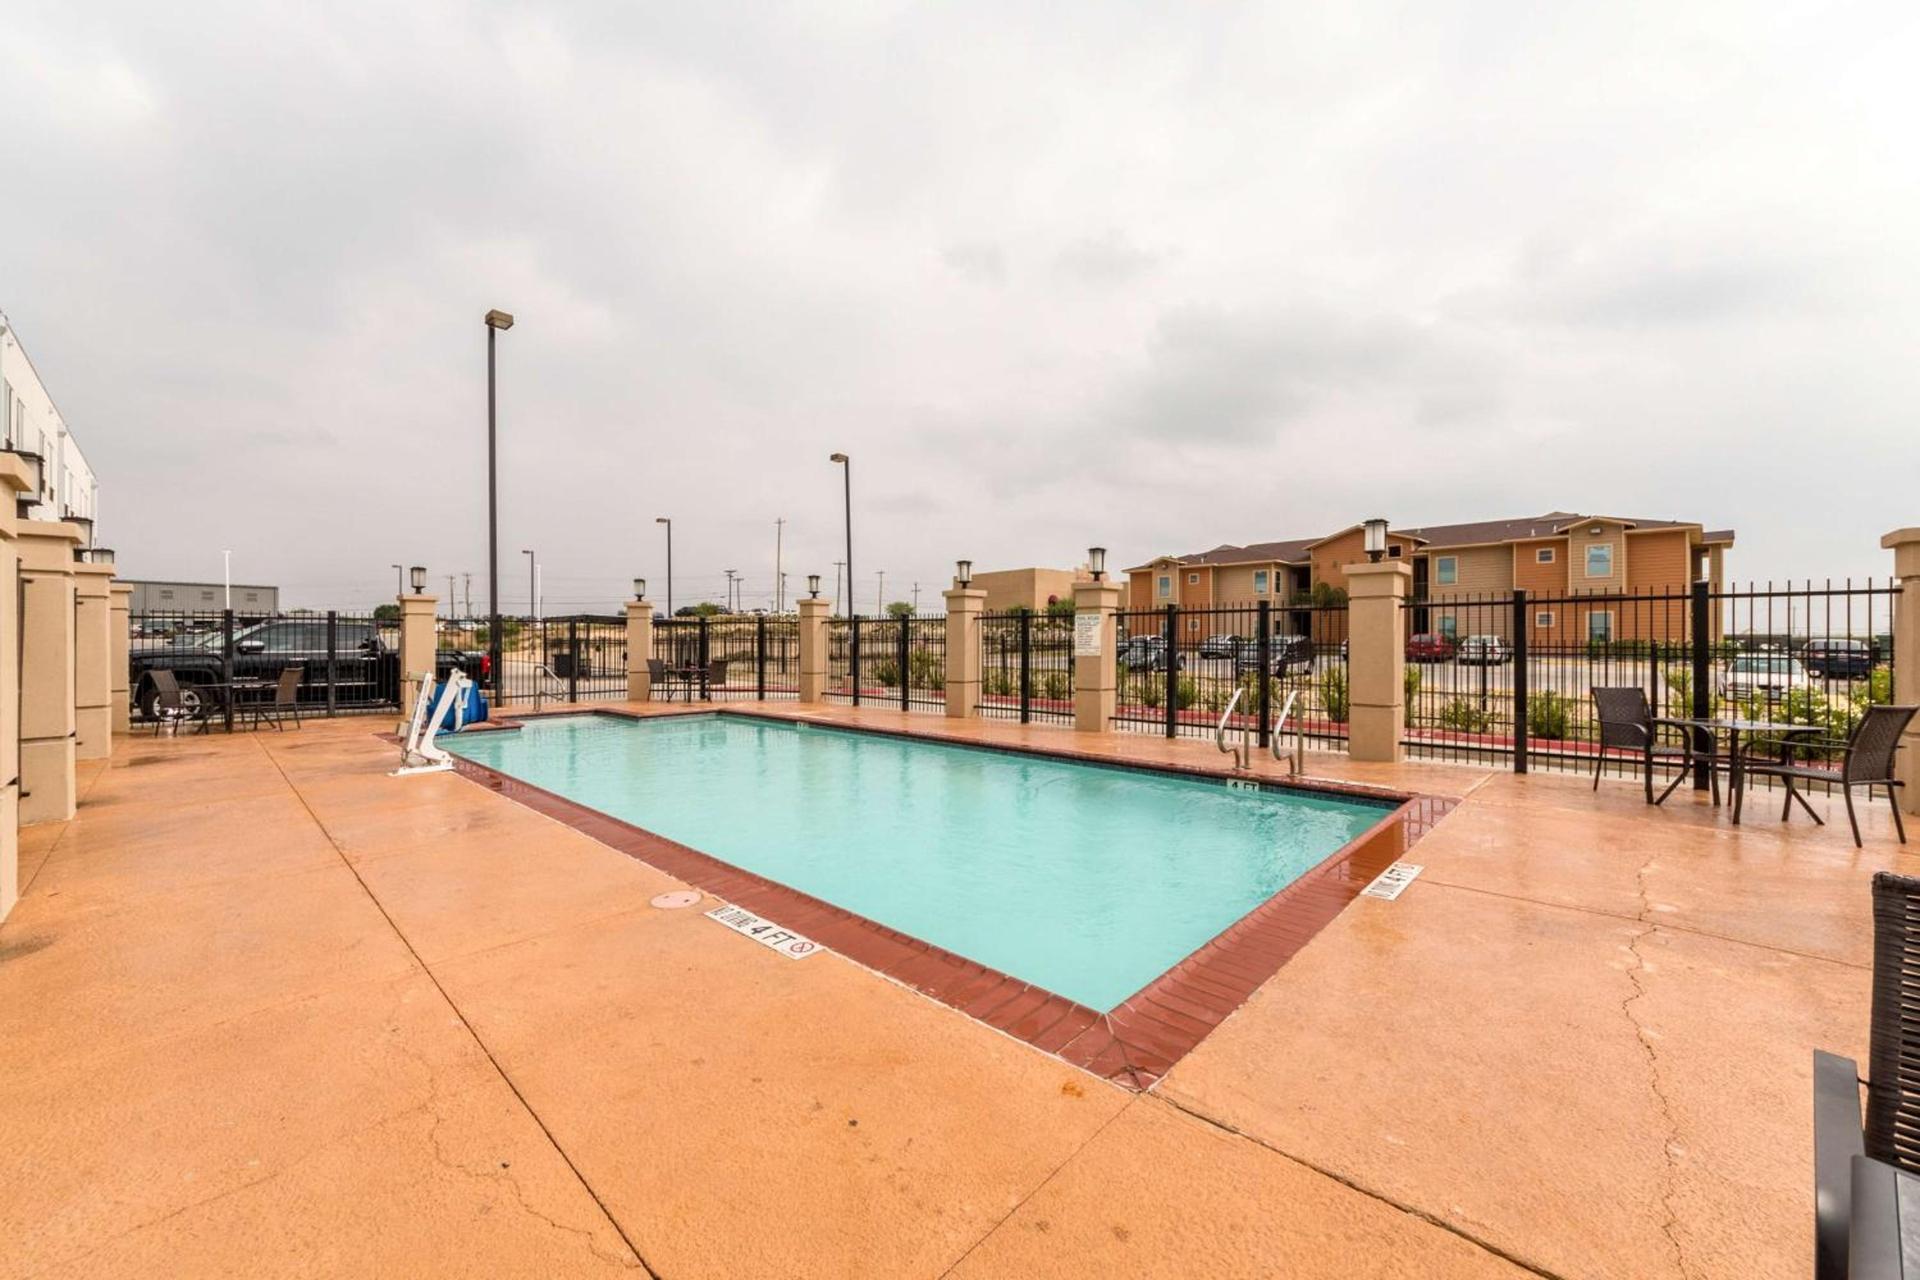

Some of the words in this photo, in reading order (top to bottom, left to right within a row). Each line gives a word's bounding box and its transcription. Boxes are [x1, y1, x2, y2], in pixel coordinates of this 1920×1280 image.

[1244, 782, 1257, 790] FT
[751, 926, 773, 935] 4
[762, 931, 797, 945] FT
